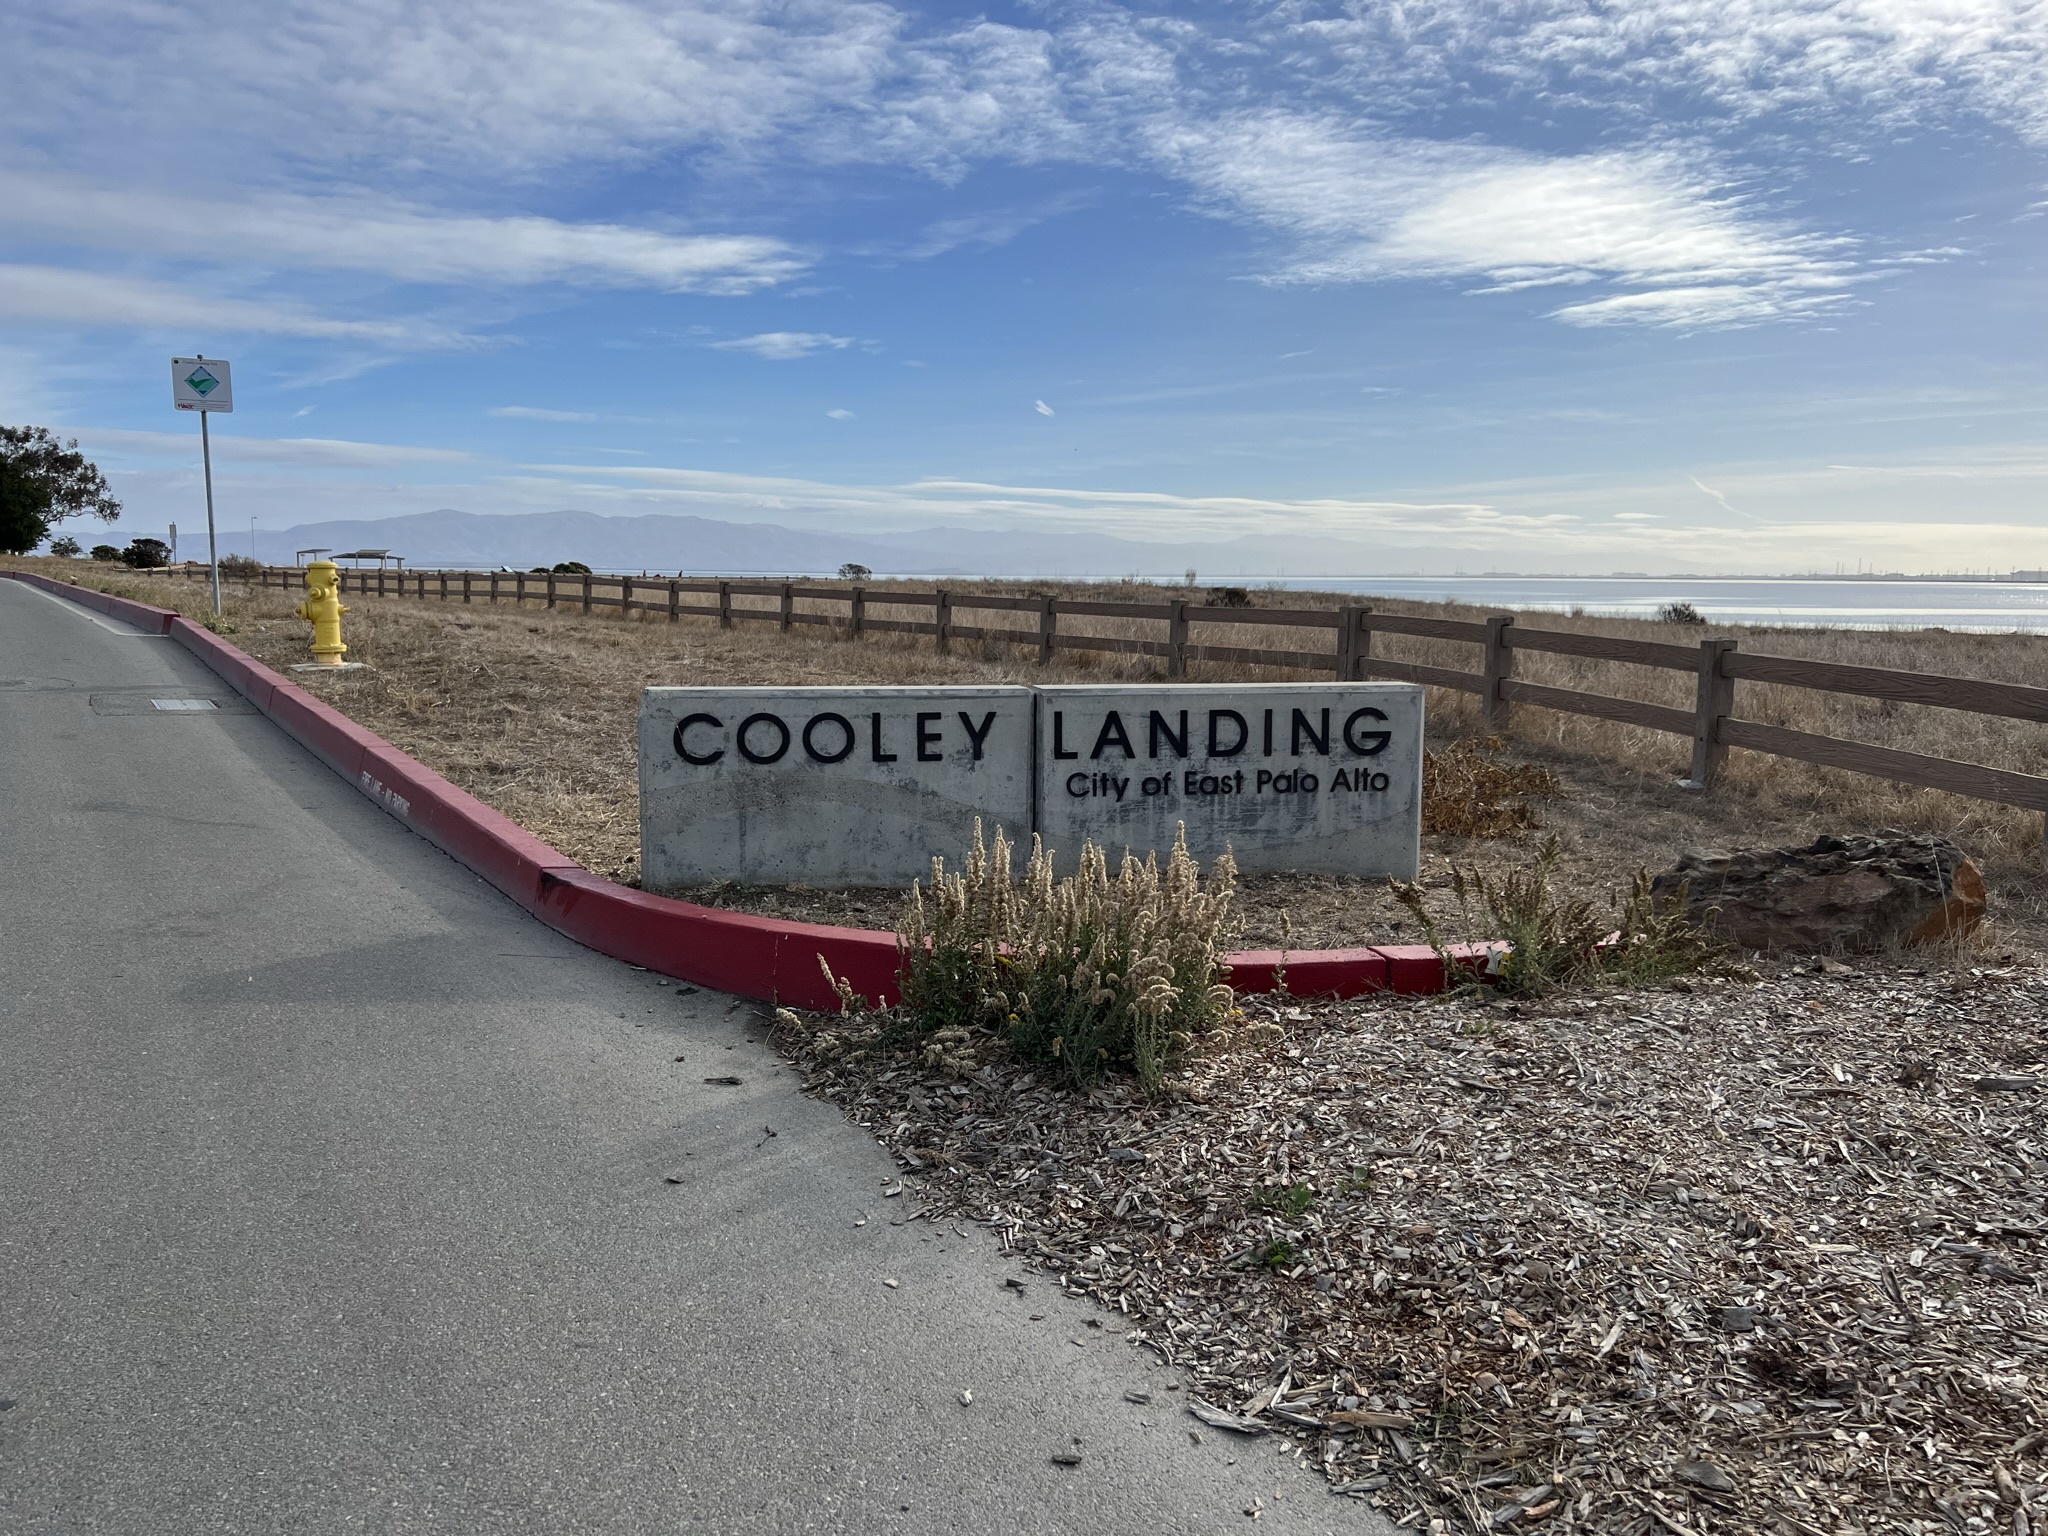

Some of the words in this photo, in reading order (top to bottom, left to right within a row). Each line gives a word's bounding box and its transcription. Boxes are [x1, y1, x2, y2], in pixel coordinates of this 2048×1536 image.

[672, 711, 998, 766] COOLEY
[1053, 706, 1392, 760] LANDING
[1065, 771, 1130, 803] City
[1141, 771, 1175, 796] of
[1184, 770, 1245, 796] East
[1256, 768, 1320, 795] Palo
[1330, 767, 1391, 794] Alto
